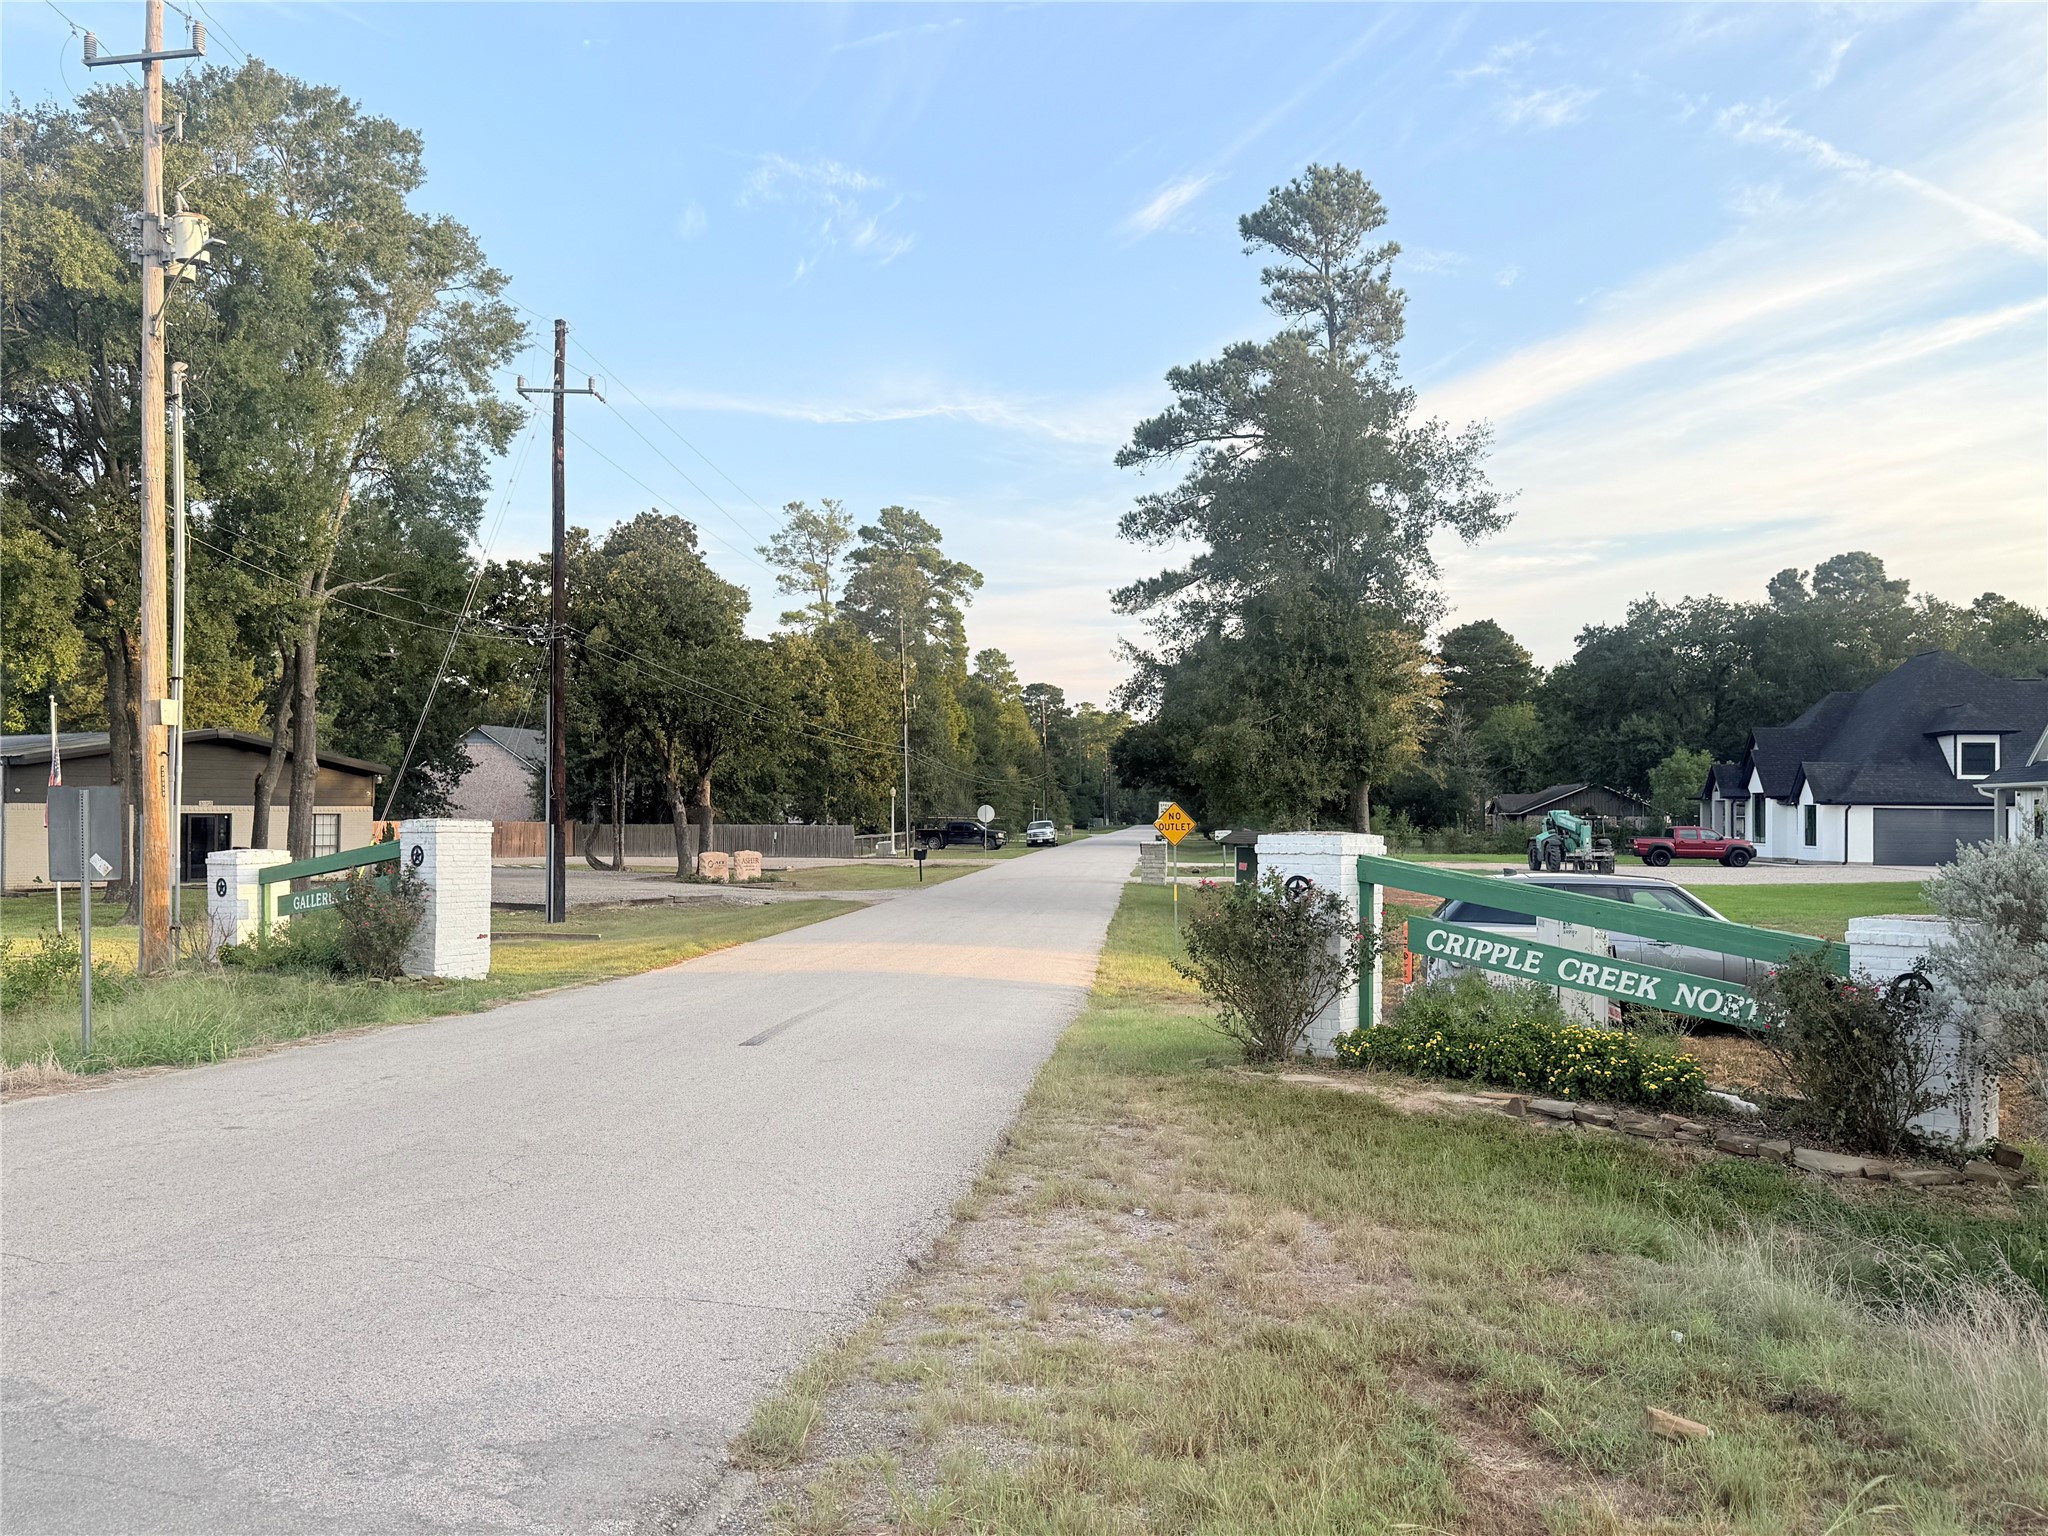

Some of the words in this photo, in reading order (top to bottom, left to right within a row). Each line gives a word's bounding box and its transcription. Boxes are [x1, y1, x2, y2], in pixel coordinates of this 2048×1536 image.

[1168, 812, 1181, 820] NO
[1158, 822, 1191, 831] OUTLET
[293, 892, 338, 910] GALLERI
[1426, 929, 1544, 974] CRIPPLE
[1557, 958, 1661, 1000] CREEK
[1672, 983, 1785, 1027] NORT
